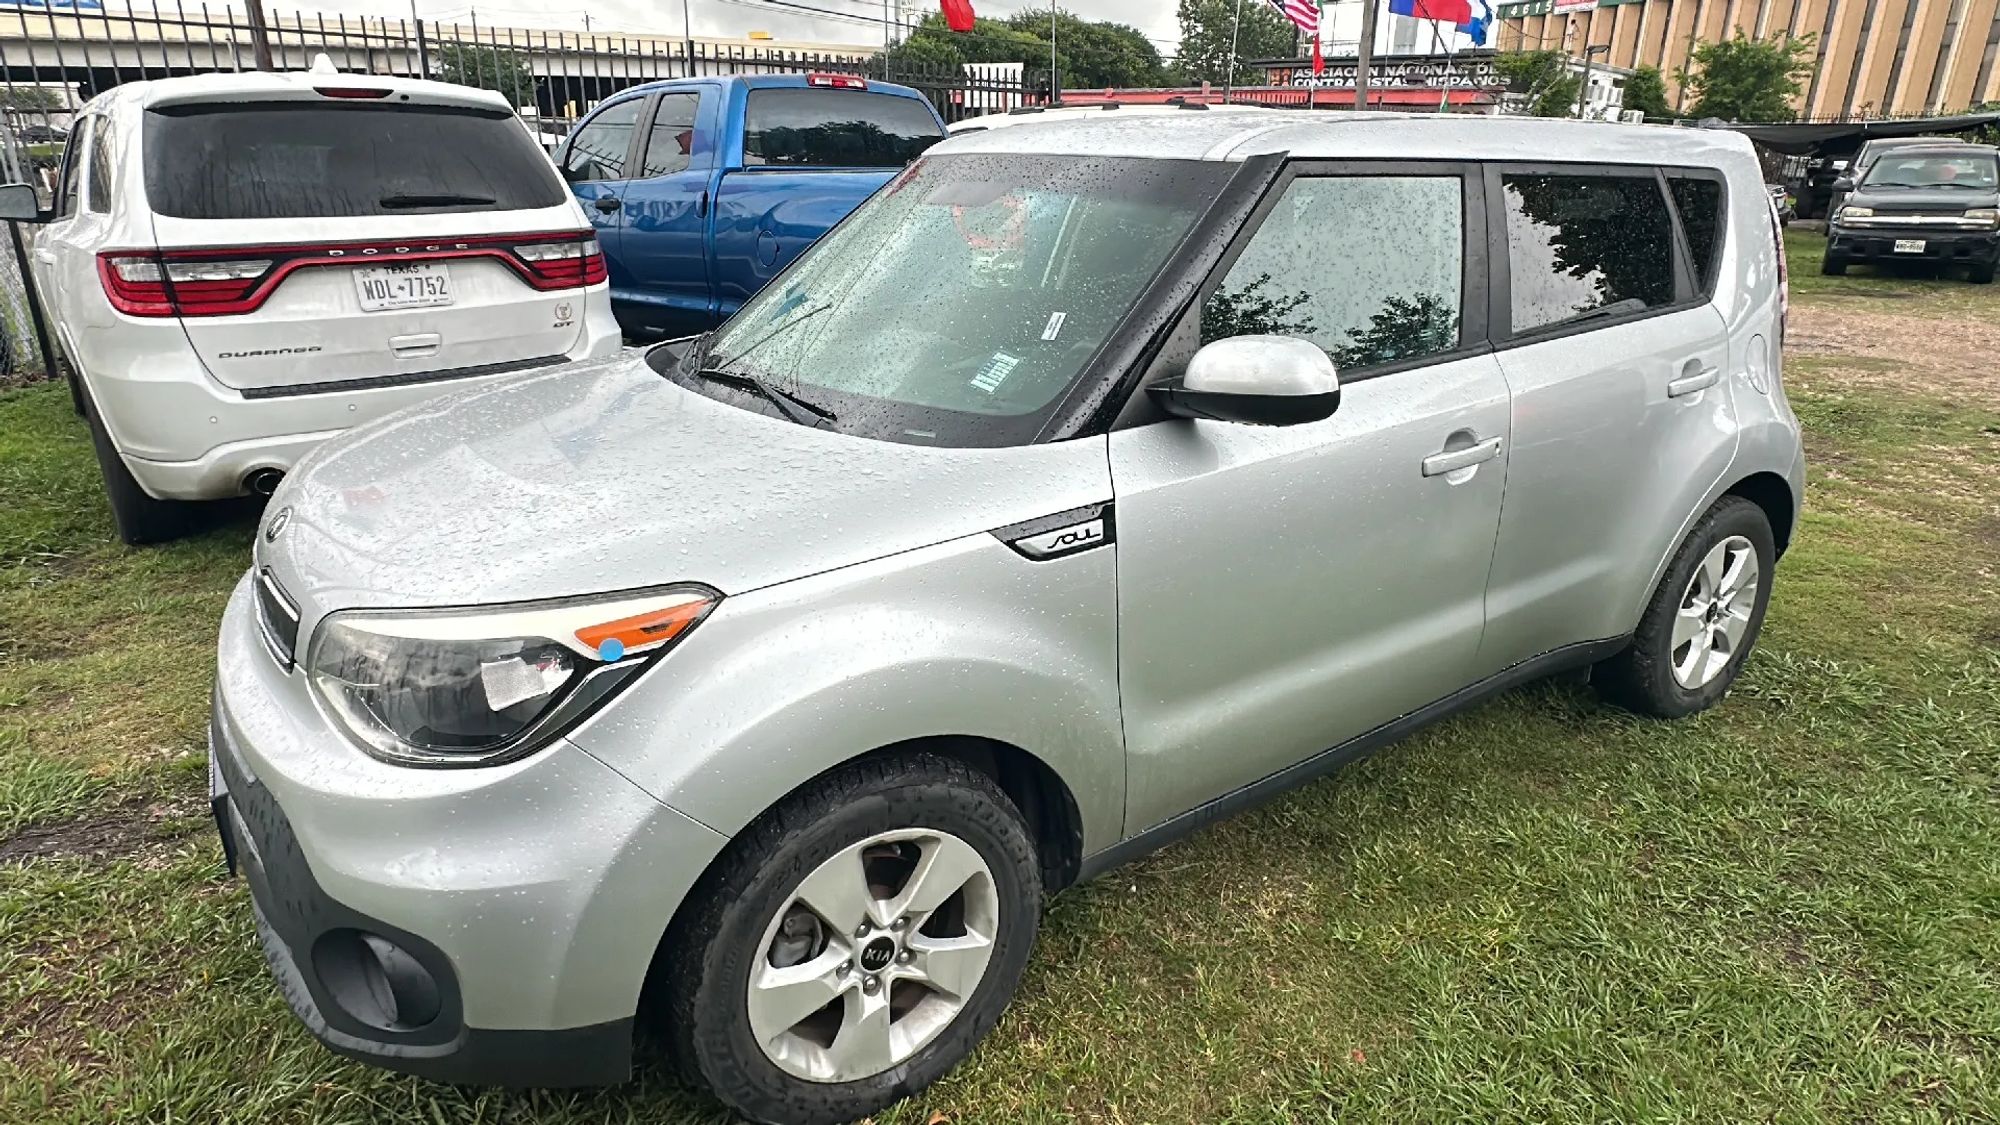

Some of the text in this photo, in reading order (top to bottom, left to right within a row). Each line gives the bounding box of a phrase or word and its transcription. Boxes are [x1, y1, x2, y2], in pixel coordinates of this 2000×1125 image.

[1510, 2, 1553, 16] 4615
[1294, 66, 1379, 78] ASCIACIN
[1294, 77, 1408, 87] CONTRAISTAS
[328, 243, 468, 256] DODGE
[384, 264, 419, 274] TEXAS
[218, 346, 322, 358] DURANGO
[1047, 528, 1101, 549] SOUL
[865, 948, 890, 961] KIA
